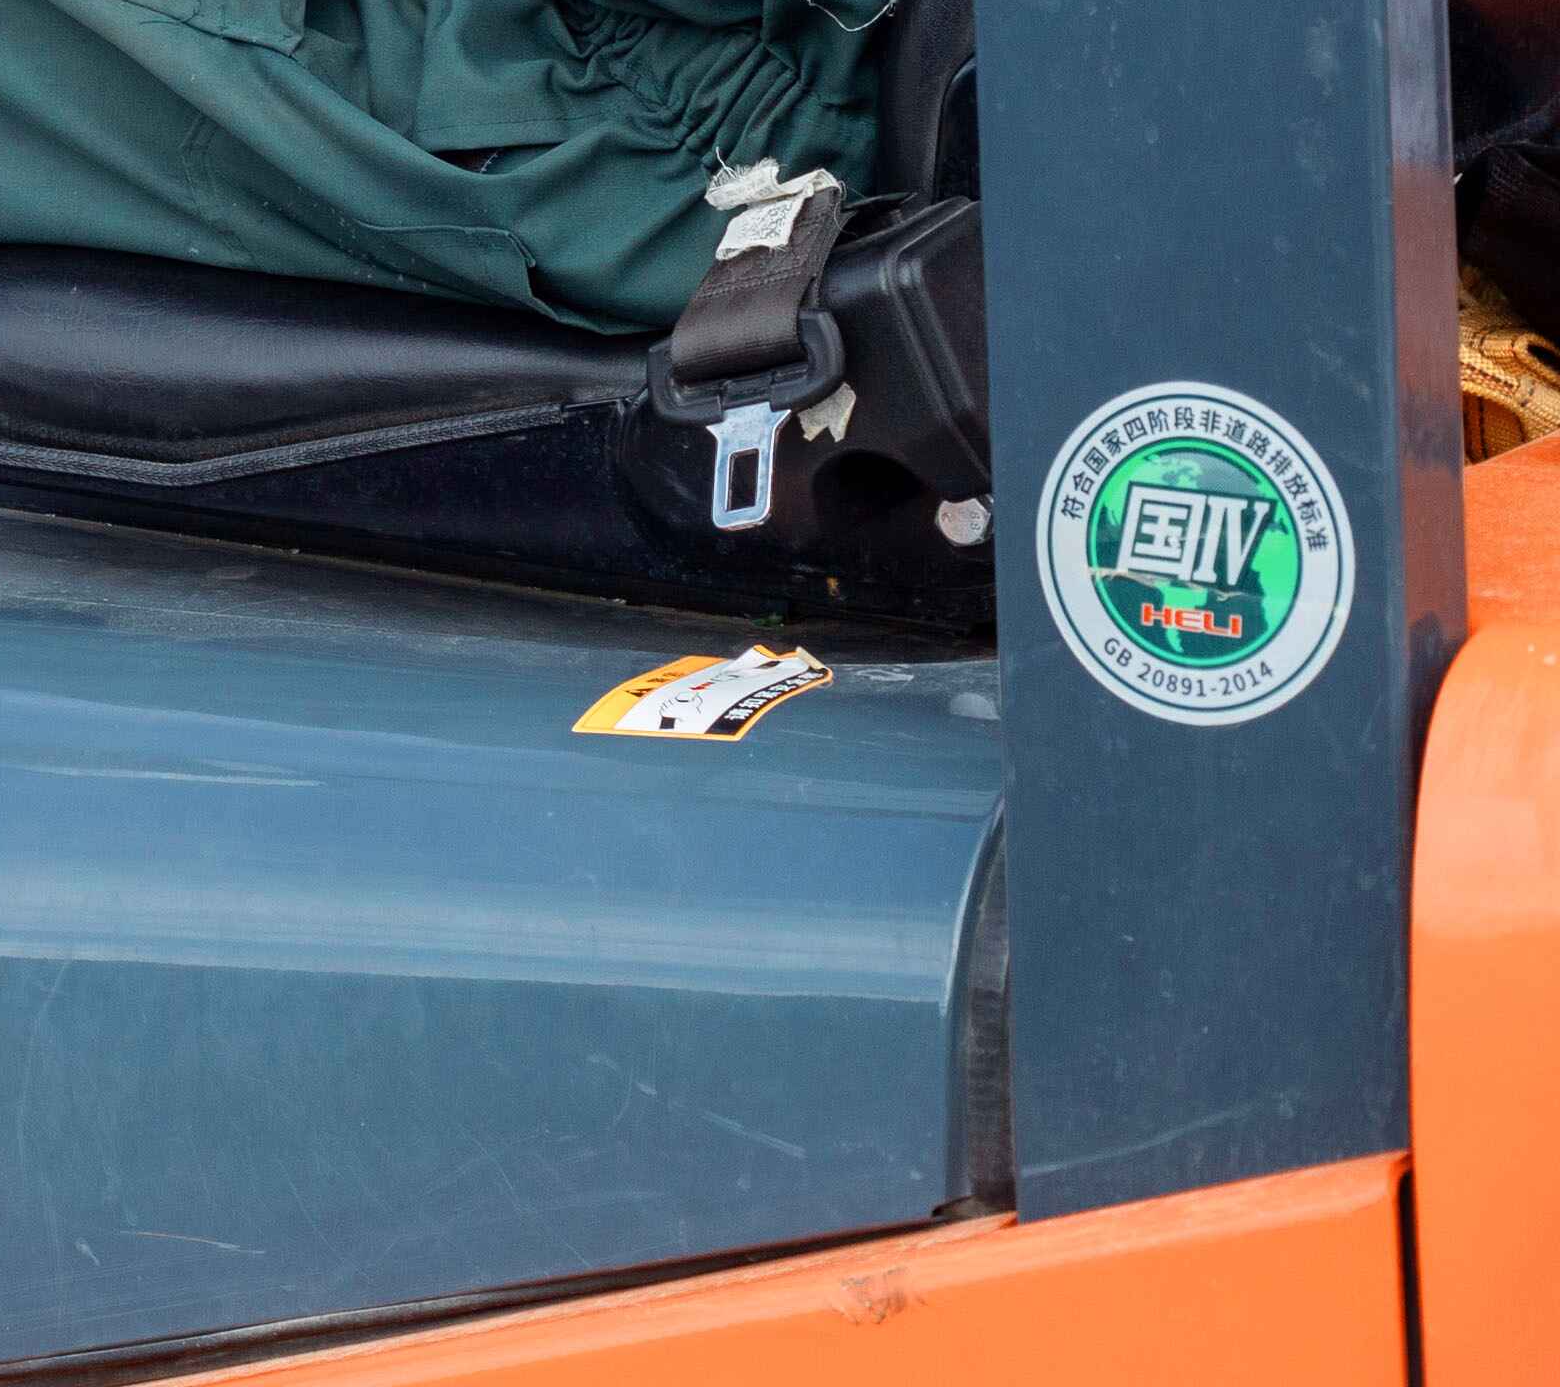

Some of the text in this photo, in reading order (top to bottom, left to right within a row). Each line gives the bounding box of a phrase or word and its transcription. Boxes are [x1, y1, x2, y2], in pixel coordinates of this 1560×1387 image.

[1060, 406, 1331, 553] 符合国家四阶段非道路排放标准
[1139, 602, 1244, 639] HELI
[1103, 638, 1273, 698] GB 20891-2014
